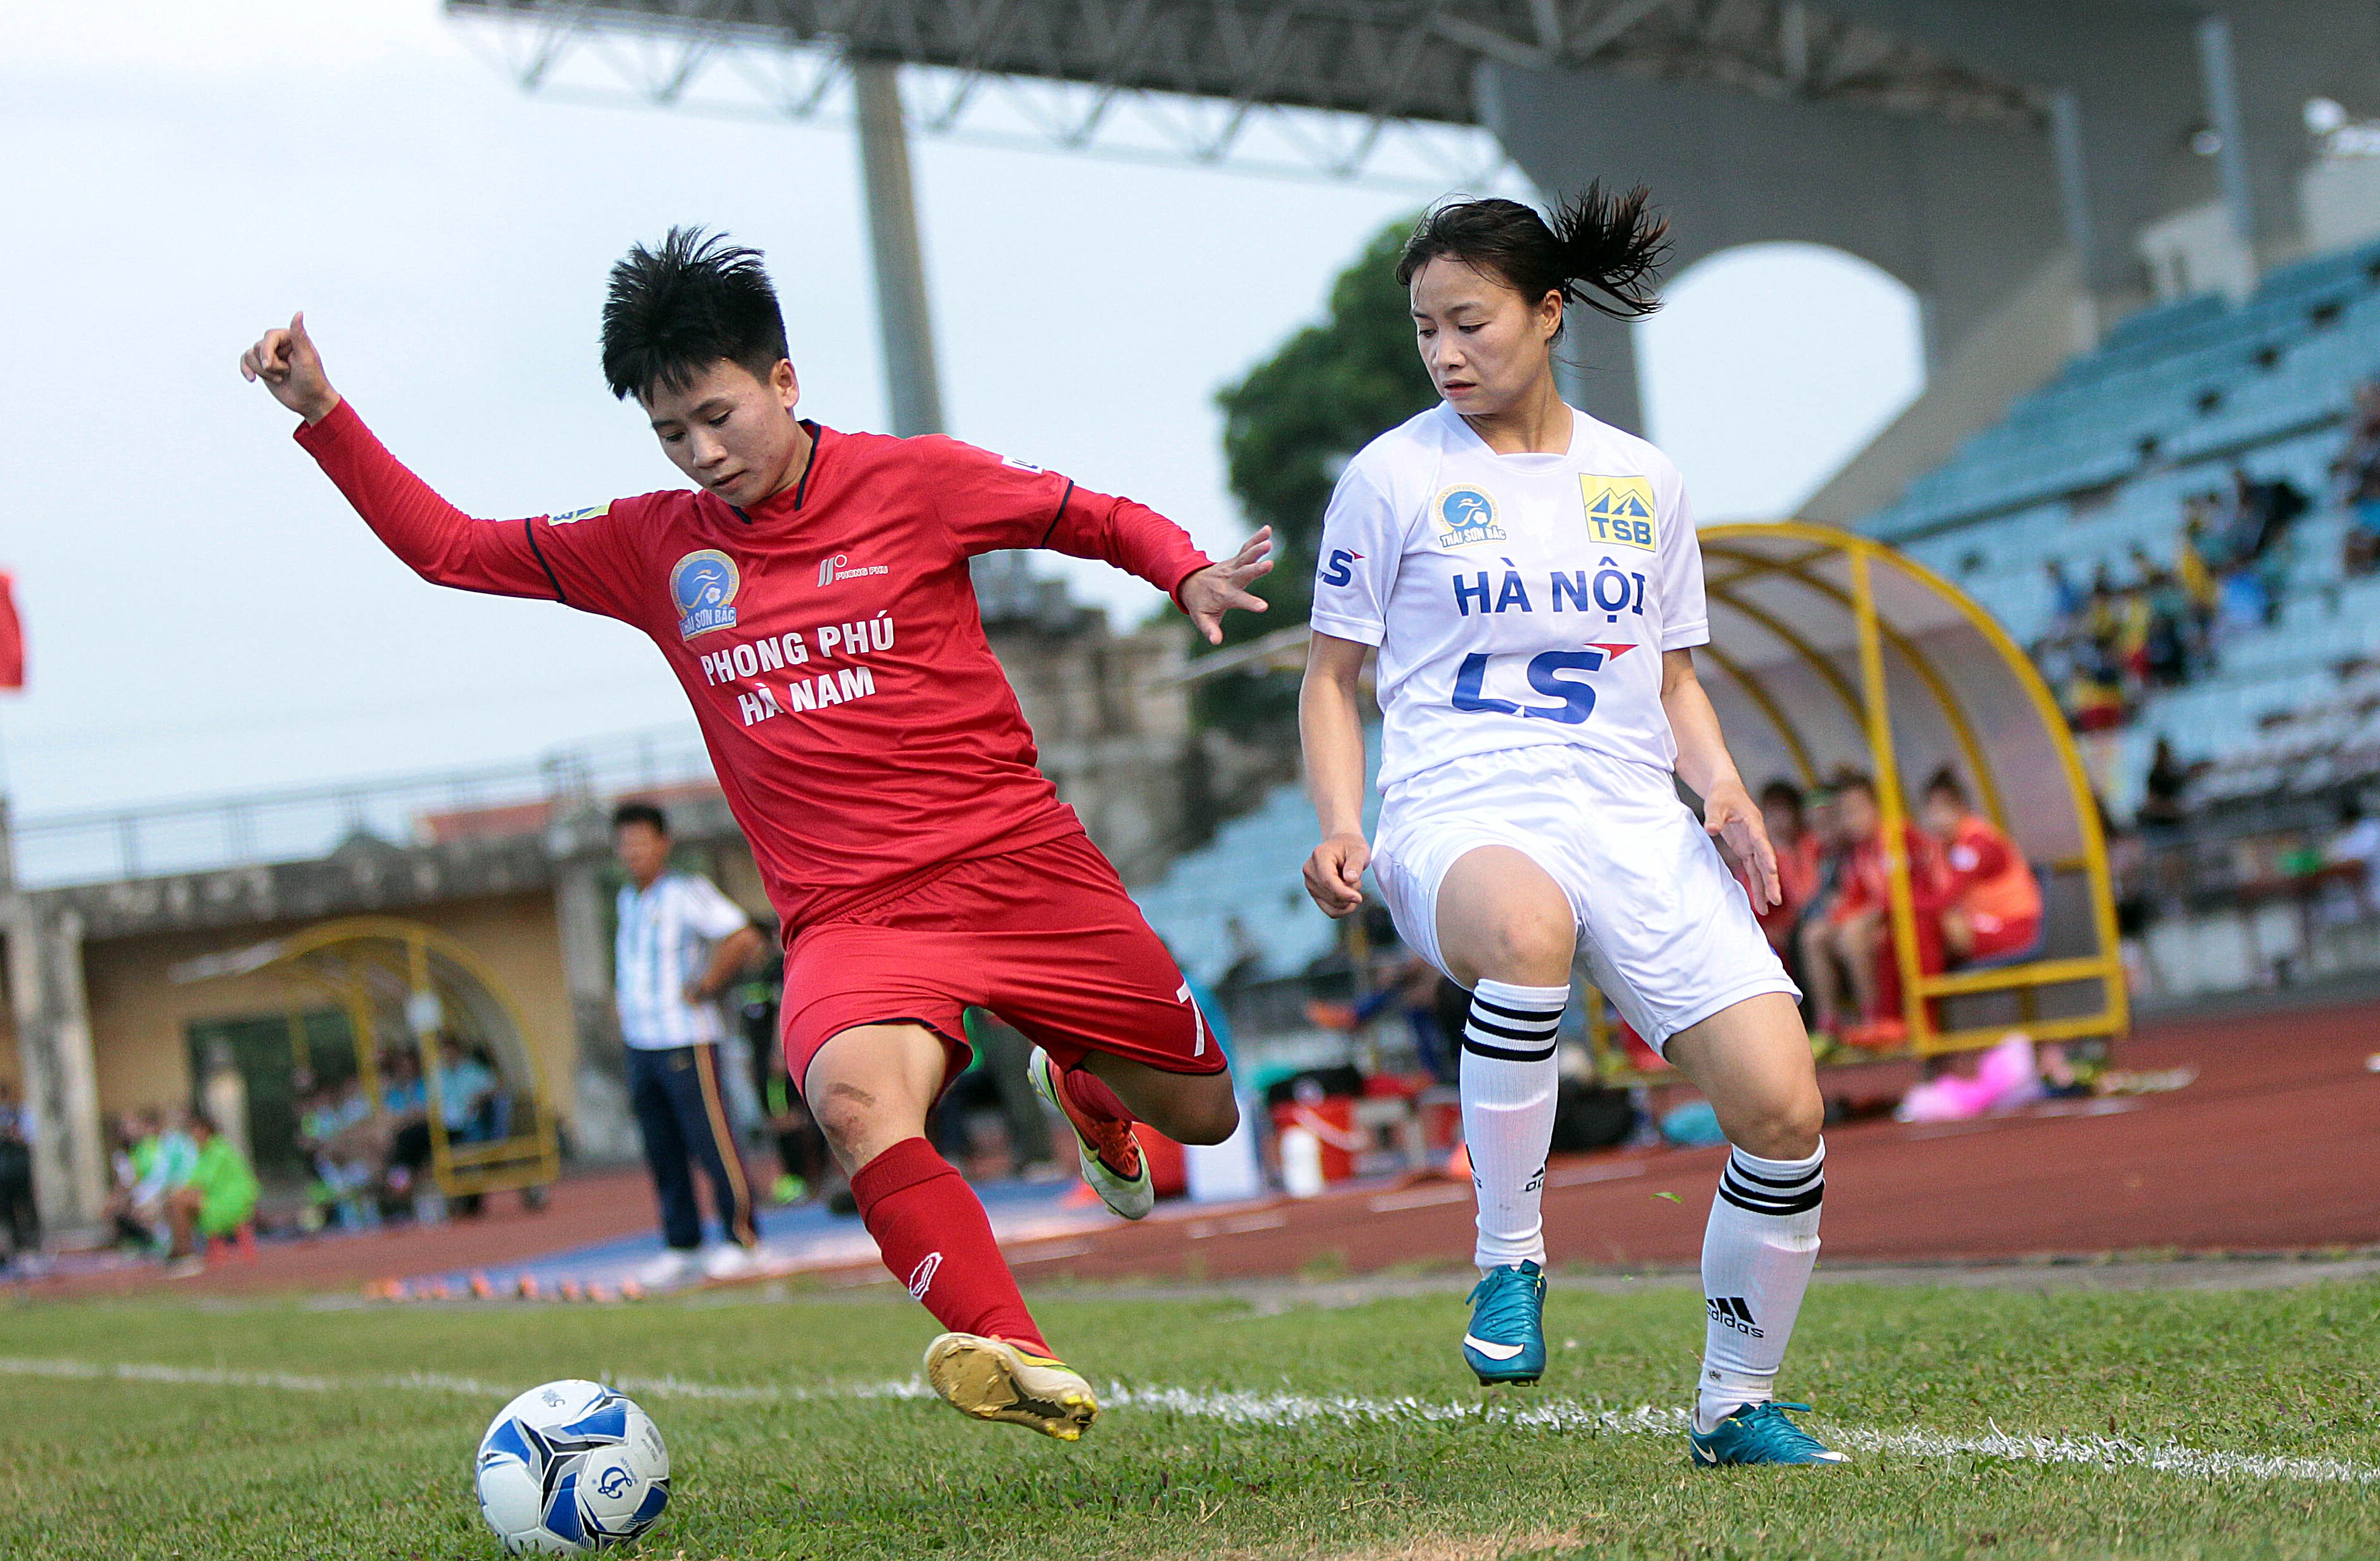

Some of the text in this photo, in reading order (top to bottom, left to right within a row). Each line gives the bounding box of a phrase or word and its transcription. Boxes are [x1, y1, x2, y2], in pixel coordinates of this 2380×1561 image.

[1590, 516, 1652, 545] TSB
[835, 567, 869, 581] PHONG
[1453, 556, 1646, 623] HÀ NỘI
[700, 609, 895, 686] PHONG PHÚ
[737, 666, 876, 727] HÀ NAM
[1452, 651, 1604, 725] LS
